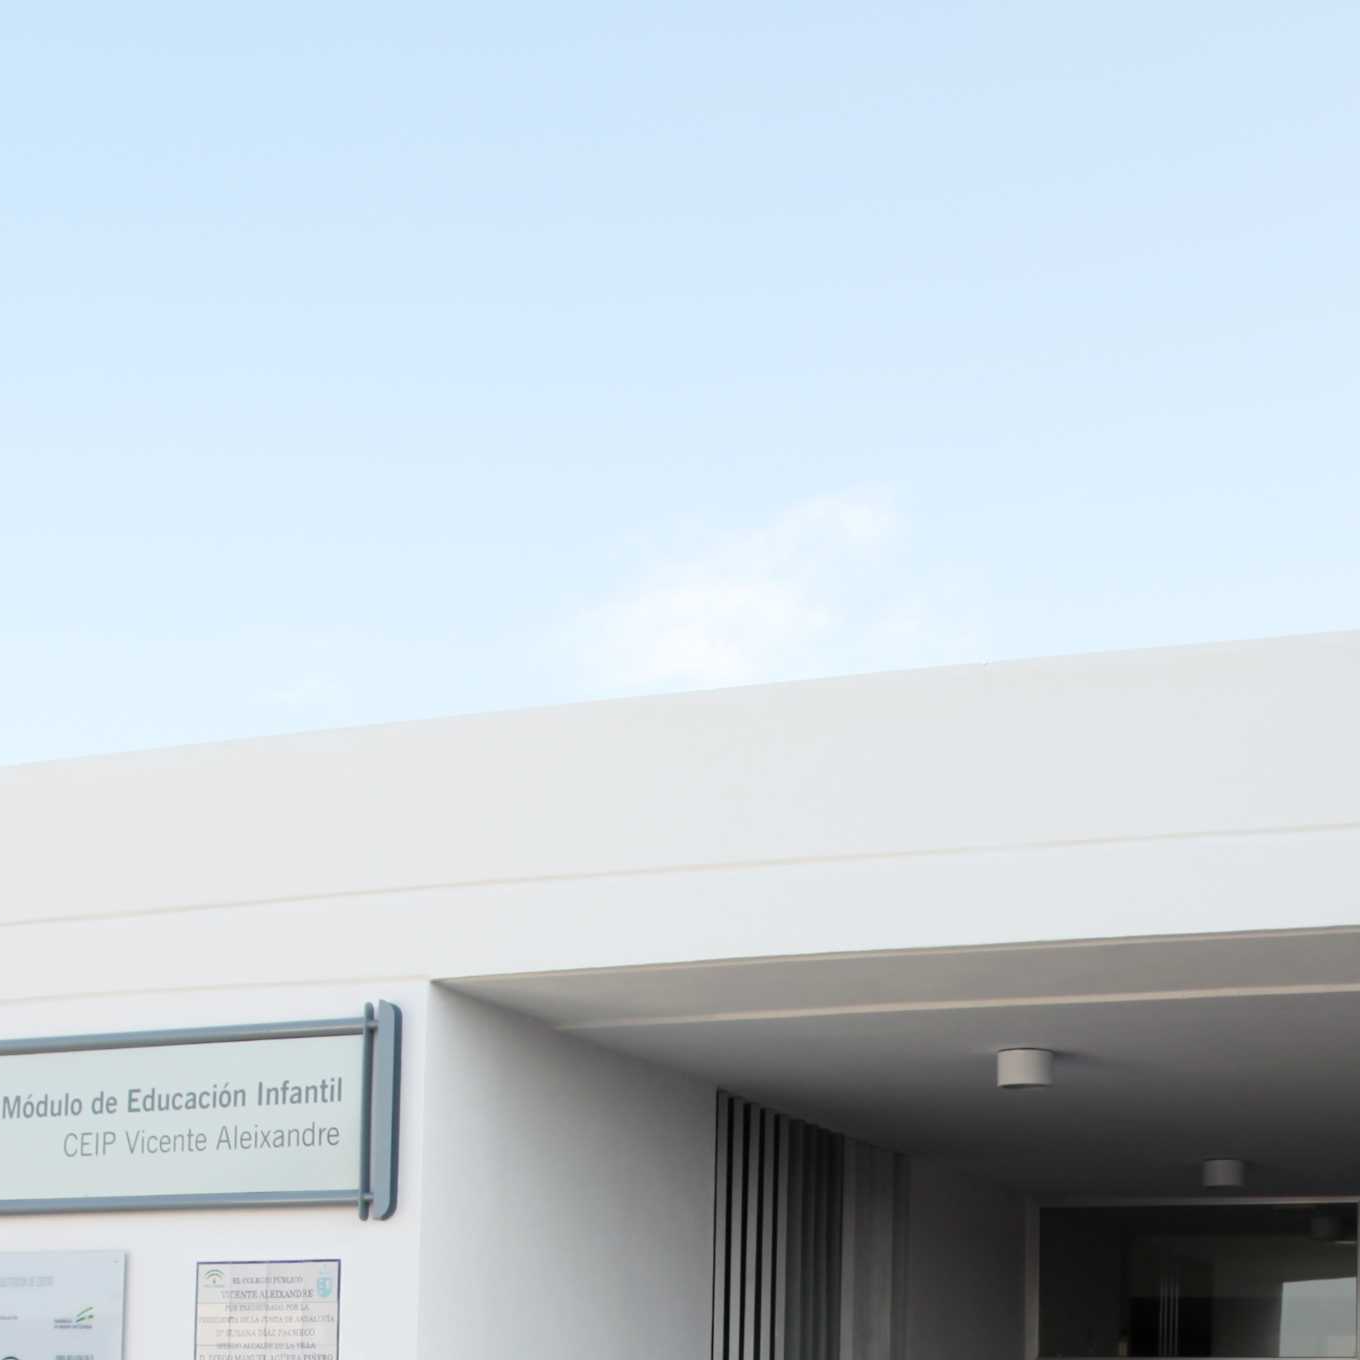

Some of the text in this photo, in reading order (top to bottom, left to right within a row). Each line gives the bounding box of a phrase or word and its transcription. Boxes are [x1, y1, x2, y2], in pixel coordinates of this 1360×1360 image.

[1, 1077, 343, 1119] Módulo de Educación Infantil
[63, 1121, 340, 1158] CEIP Vicente Aleixandre
